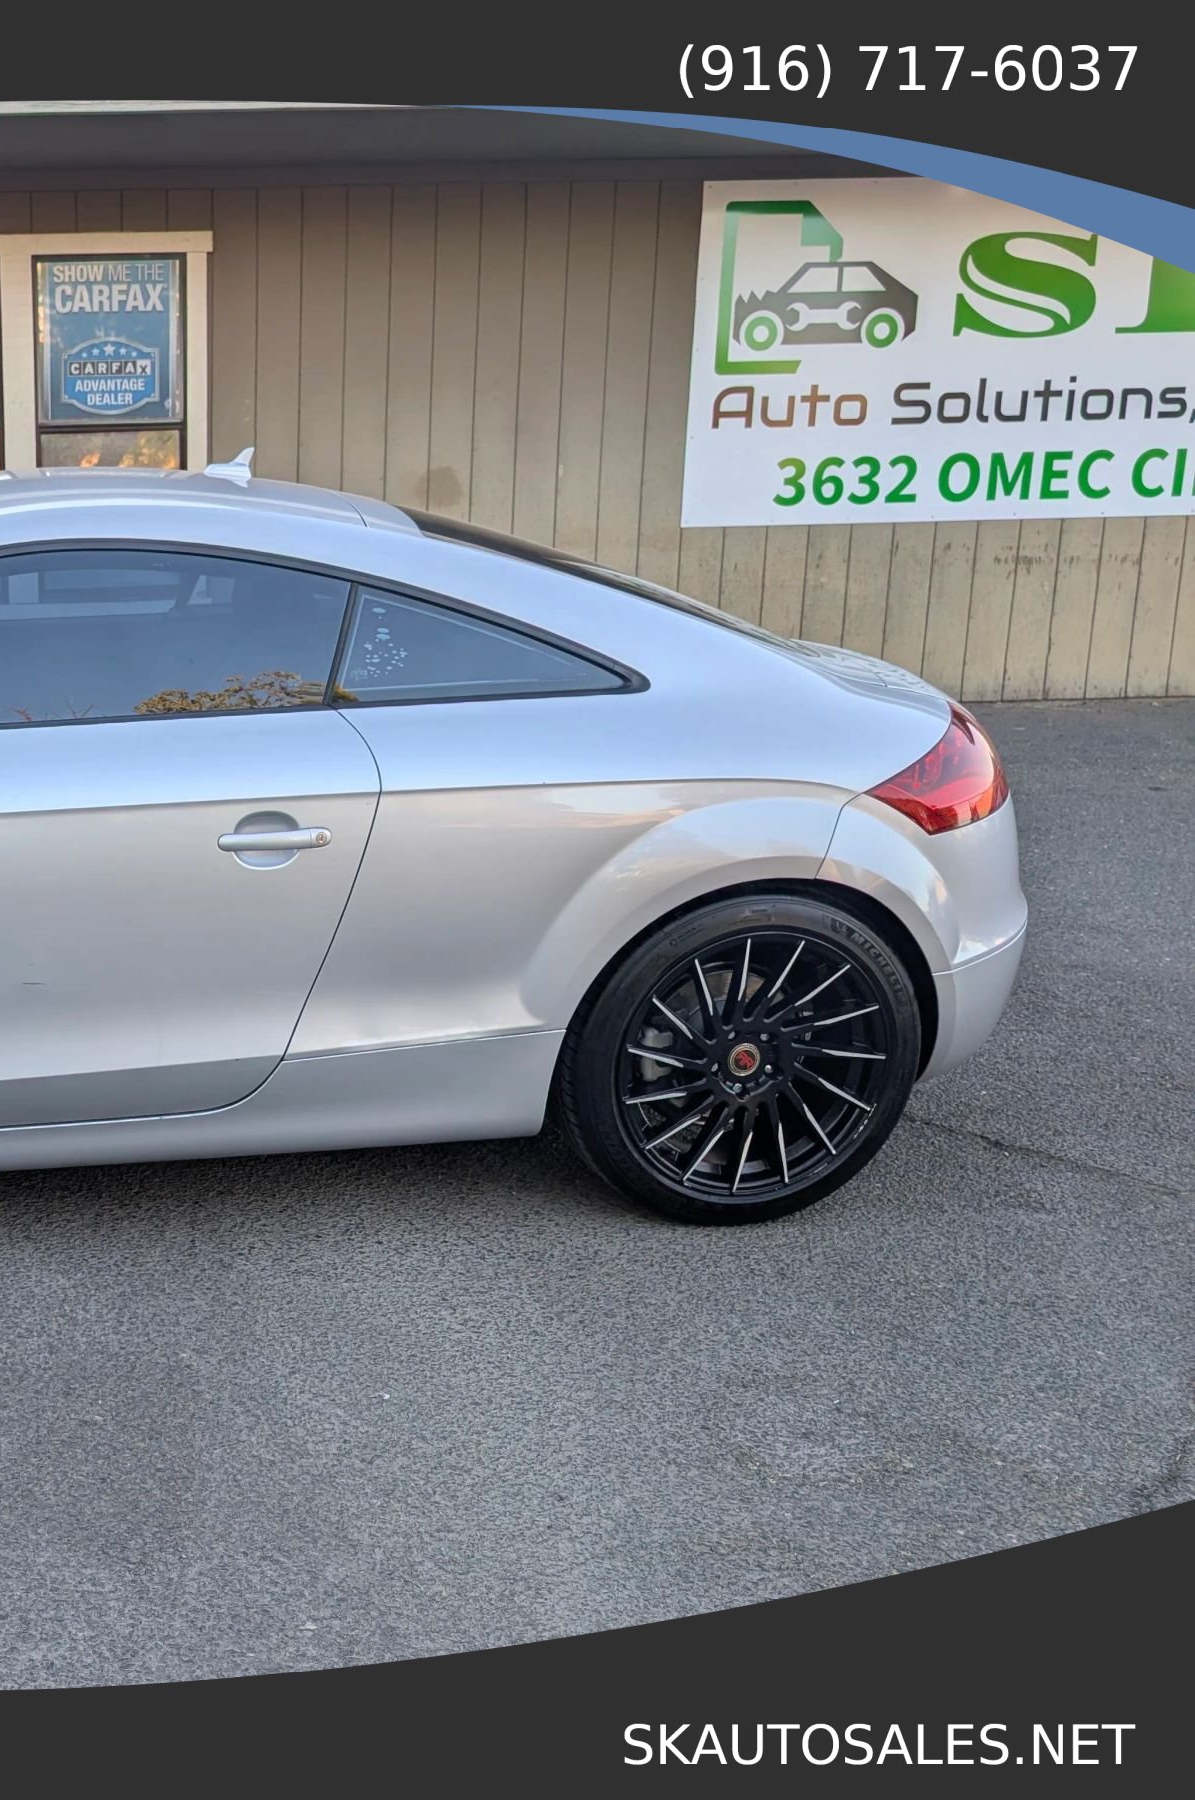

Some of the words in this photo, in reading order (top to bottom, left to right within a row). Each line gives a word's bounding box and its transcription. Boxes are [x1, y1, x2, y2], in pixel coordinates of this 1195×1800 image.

[53, 264, 104, 282] SHOW
[108, 264, 132, 281] ME
[134, 264, 165, 281] THE
[954, 231, 1195, 338] S
[55, 283, 165, 313] CARFAX
[69, 360, 151, 375] CARFAX
[75, 378, 146, 392] ADVANTAGE
[87, 392, 133, 406] DEALER
[711, 385, 868, 429] Auto
[774, 456, 918, 507] 3632
[937, 450, 1115, 503] OMEC
[1131, 448, 1195, 498] CI
